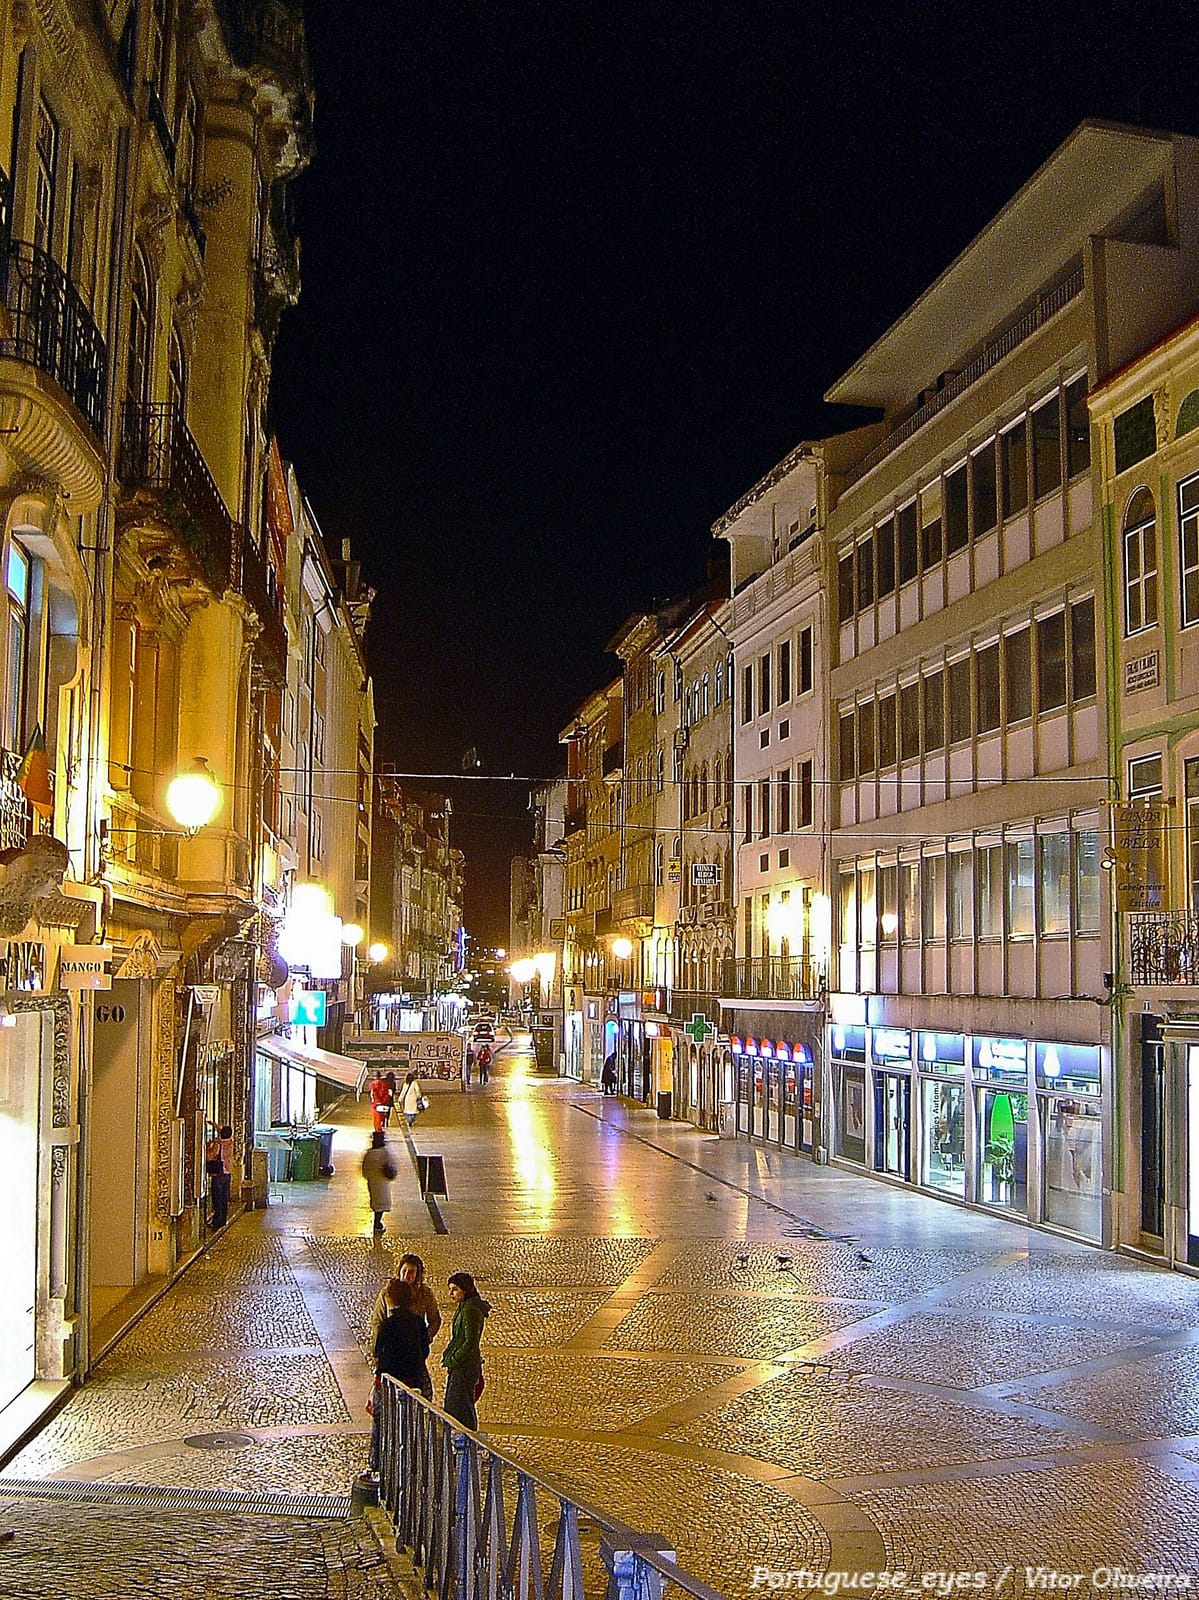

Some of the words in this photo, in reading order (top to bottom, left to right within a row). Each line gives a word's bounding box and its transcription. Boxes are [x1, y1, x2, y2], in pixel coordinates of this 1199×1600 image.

[1120, 809, 1160, 821] LINDA
[1120, 837, 1160, 849] BELA
[61, 961, 101, 973] MANGO
[95, 1004, 126, 1024] GO
